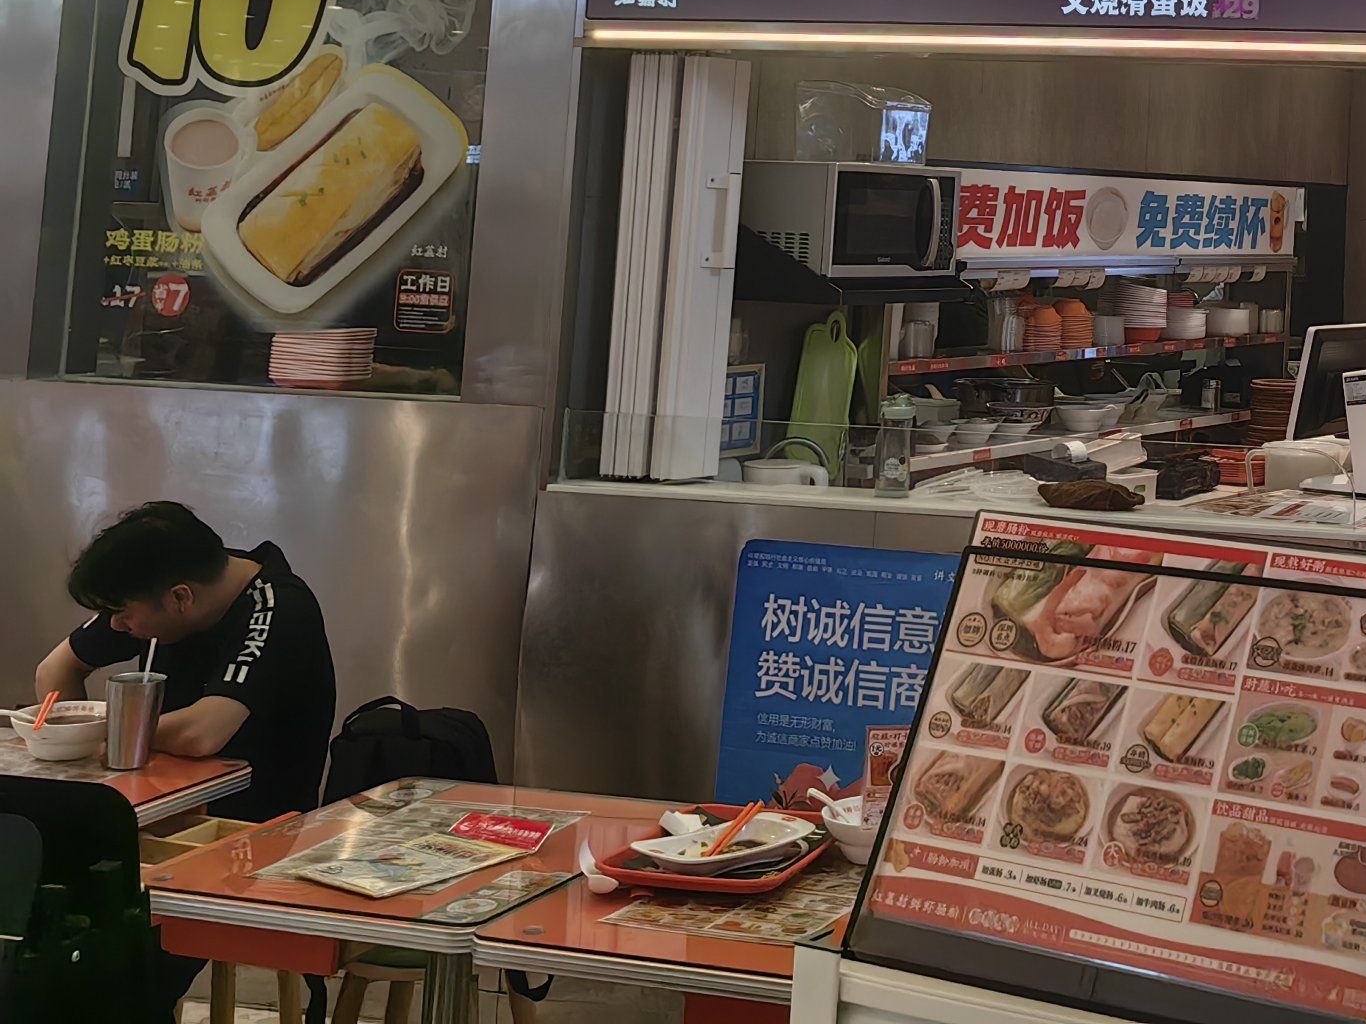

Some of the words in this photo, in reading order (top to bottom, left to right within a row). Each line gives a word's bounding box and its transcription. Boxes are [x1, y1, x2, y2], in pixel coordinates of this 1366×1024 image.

[105, 228, 204, 253] 鸡蛋肠粉
[1136, 190, 1271, 250] 免费续杯
[400, 275, 450, 292] 工作日
[761, 593, 944, 655] 树诚信意
